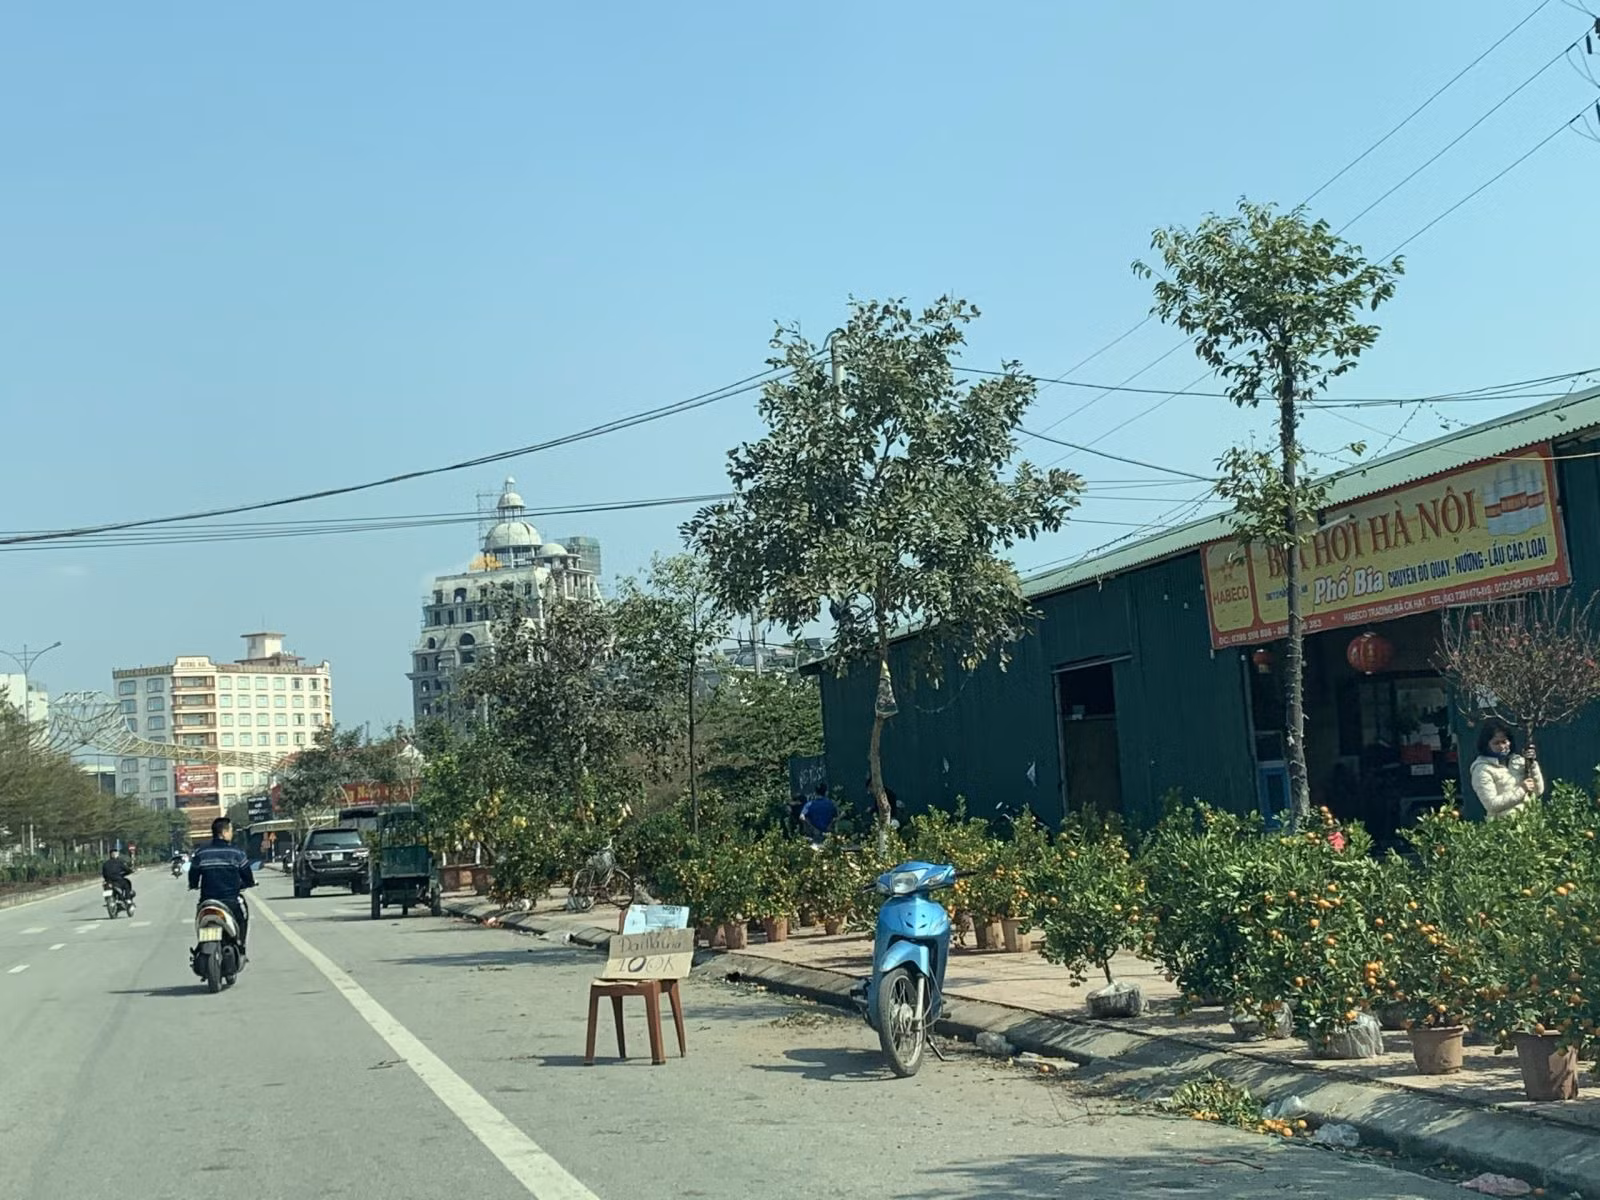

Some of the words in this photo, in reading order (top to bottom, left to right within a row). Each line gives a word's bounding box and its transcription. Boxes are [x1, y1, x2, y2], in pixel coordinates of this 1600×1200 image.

[1368, 501, 1414, 553] HÀ
[1416, 486, 1480, 544] NỘI
[1314, 564, 1350, 605] Phố
[1352, 567, 1385, 597] Bia
[1387, 564, 1418, 589] CHUYÊN
[1430, 559, 1451, 581] QUAY
[1506, 539, 1525, 562] CÁC
[1526, 537, 1548, 562] LOẠI
[1213, 586, 1250, 605] HABECO
